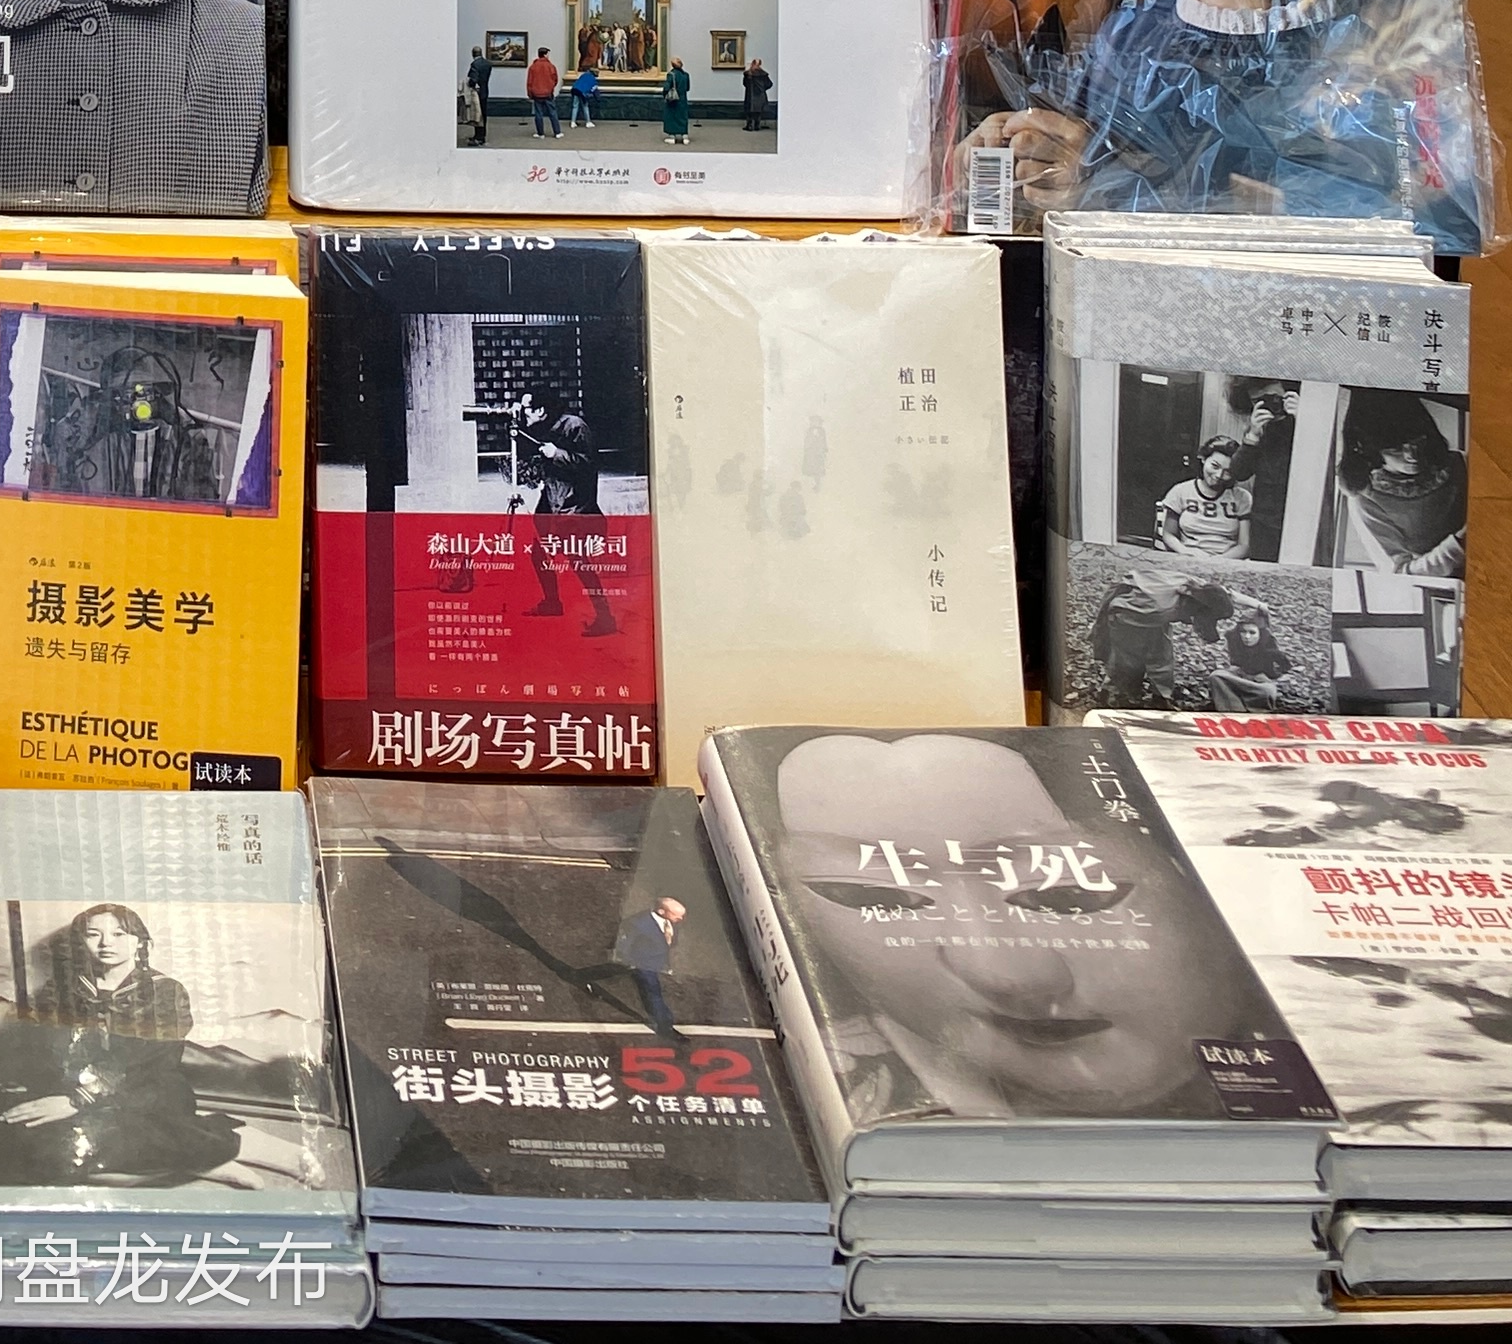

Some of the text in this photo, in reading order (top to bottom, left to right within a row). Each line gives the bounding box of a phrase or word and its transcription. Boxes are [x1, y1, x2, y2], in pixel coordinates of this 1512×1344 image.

[1357, 312, 1372, 342] 纪信
[897, 366, 938, 385] 植田
[899, 394, 939, 413] 正治
[427, 532, 628, 557] 森山大道 寺山修司
[429, 558, 628, 574] Daido Moriyama Shuji Terayama
[928, 544, 949, 615] 小传记
[25, 578, 216, 635] 摄影美学
[24, 635, 132, 665] 遗失与留存
[21, 709, 159, 742] ESTHÉTIQUE
[368, 709, 654, 772] 剧场写真帖
[1194, 718, 1453, 745] ROBERT CAPA
[20, 739, 80, 764] DE LA
[1195, 746, 1488, 770] SLIGHTLY OUT OF FOCUS
[193, 761, 253, 785] 试读本
[1082, 758, 1142, 822] 土门拳
[215, 813, 232, 853] 荒木经惟
[241, 813, 263, 866] 写真的话
[858, 838, 1120, 893] 生与死
[1300, 865, 1512, 899] 颤抖的镜
[859, 903, 1154, 929] 死ぬことと生きること
[1313, 900, 1512, 930] 卡帕二战回
[388, 1047, 610, 1070] STREET PHOTOGRAPHY
[1200, 1044, 1275, 1066] 试读本
[621, 1047, 761, 1096] 52
[392, 1064, 619, 1112] 街头摄影
[627, 1094, 769, 1115] 个任务清单
[631, 1114, 772, 1128] ASSIGNMENTS
